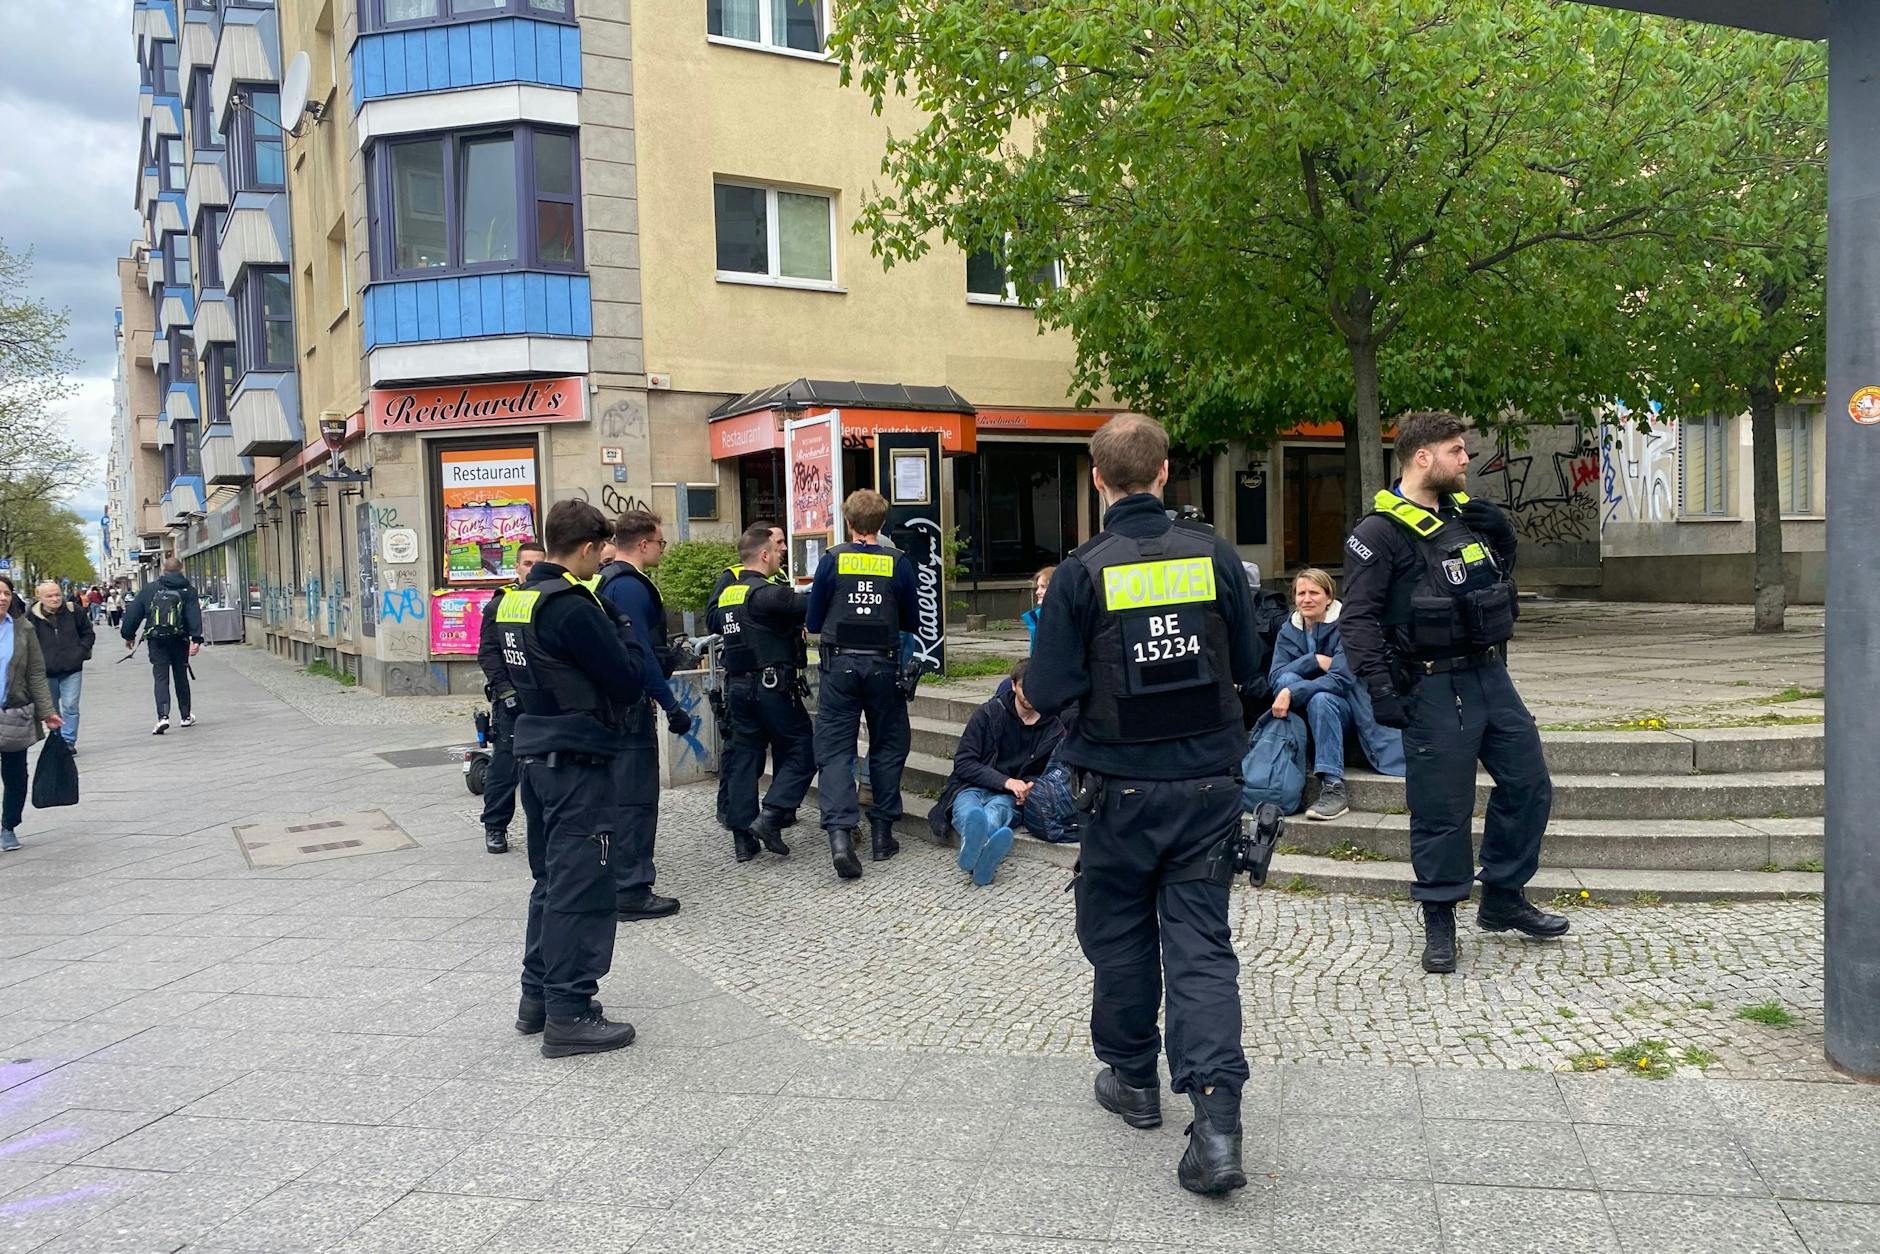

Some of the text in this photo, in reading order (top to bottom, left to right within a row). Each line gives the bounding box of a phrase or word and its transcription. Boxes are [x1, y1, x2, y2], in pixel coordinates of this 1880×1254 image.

[383, 383, 564, 426] Reichardt's
[453, 464, 526, 481] Restaurant
[1347, 535, 1373, 561] POLIZEI
[842, 556, 890, 573] POLIZEI
[857, 581, 873, 592] BE
[1107, 562, 1211, 605] POLIZEI
[847, 593, 882, 605] 15230
[725, 612, 734, 623] BE
[1149, 613, 1180, 637] BE
[723, 622, 741, 635] 15236
[504, 632, 517, 648] BE
[503, 649, 527, 666] 15235
[1133, 635, 1200, 663] 15234
